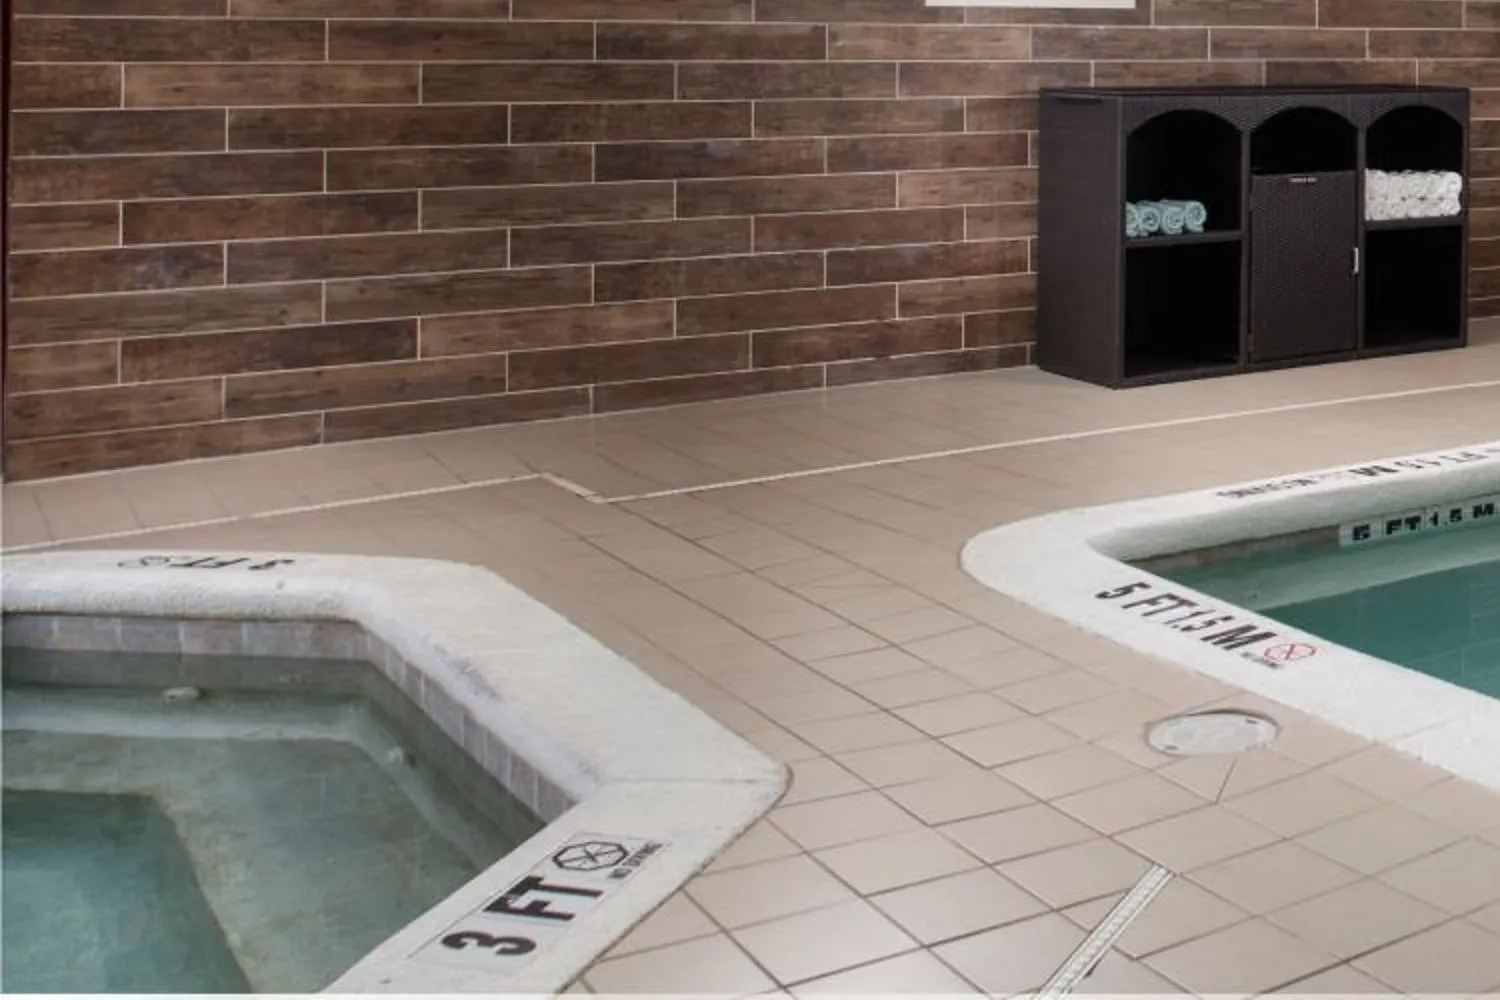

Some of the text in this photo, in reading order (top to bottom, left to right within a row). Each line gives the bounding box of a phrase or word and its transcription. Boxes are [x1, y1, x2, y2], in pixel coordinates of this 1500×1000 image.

[1386, 516, 1421, 535] FT
[1095, 582, 1152, 599] 5
[1121, 592, 1201, 617] FT
[1200, 624, 1278, 650] M
[441, 875, 604, 955] 3 FT
